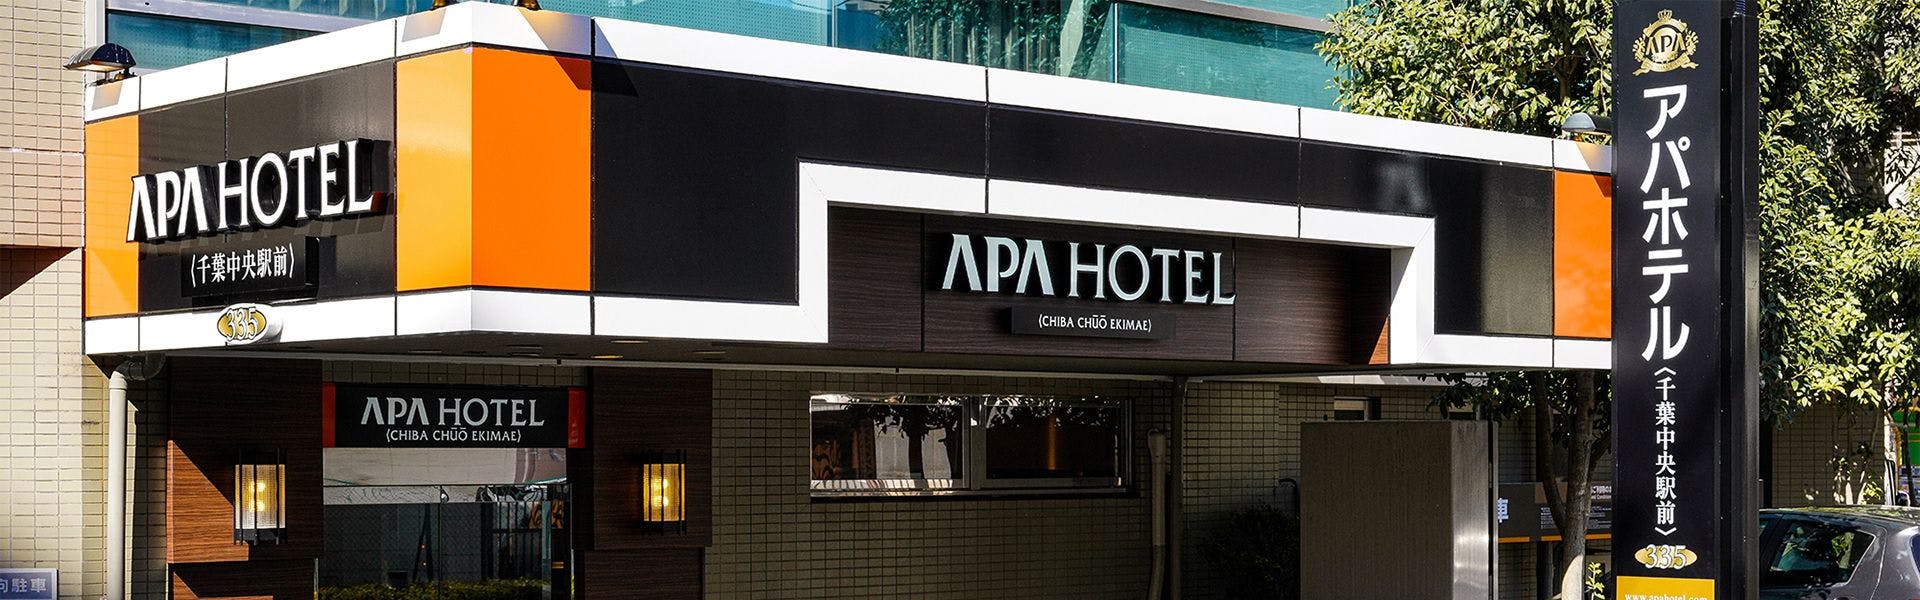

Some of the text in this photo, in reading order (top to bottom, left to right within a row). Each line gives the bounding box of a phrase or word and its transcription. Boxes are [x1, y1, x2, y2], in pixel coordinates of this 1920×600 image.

[127, 139, 375, 242] APA HOTEL
[1640, 84, 1691, 362] アパホテル
[942, 233, 1237, 305] APA HOTEL
[225, 306, 259, 341] 335
[360, 396, 545, 427] APA HOTEL
[1645, 544, 1688, 570] 335
